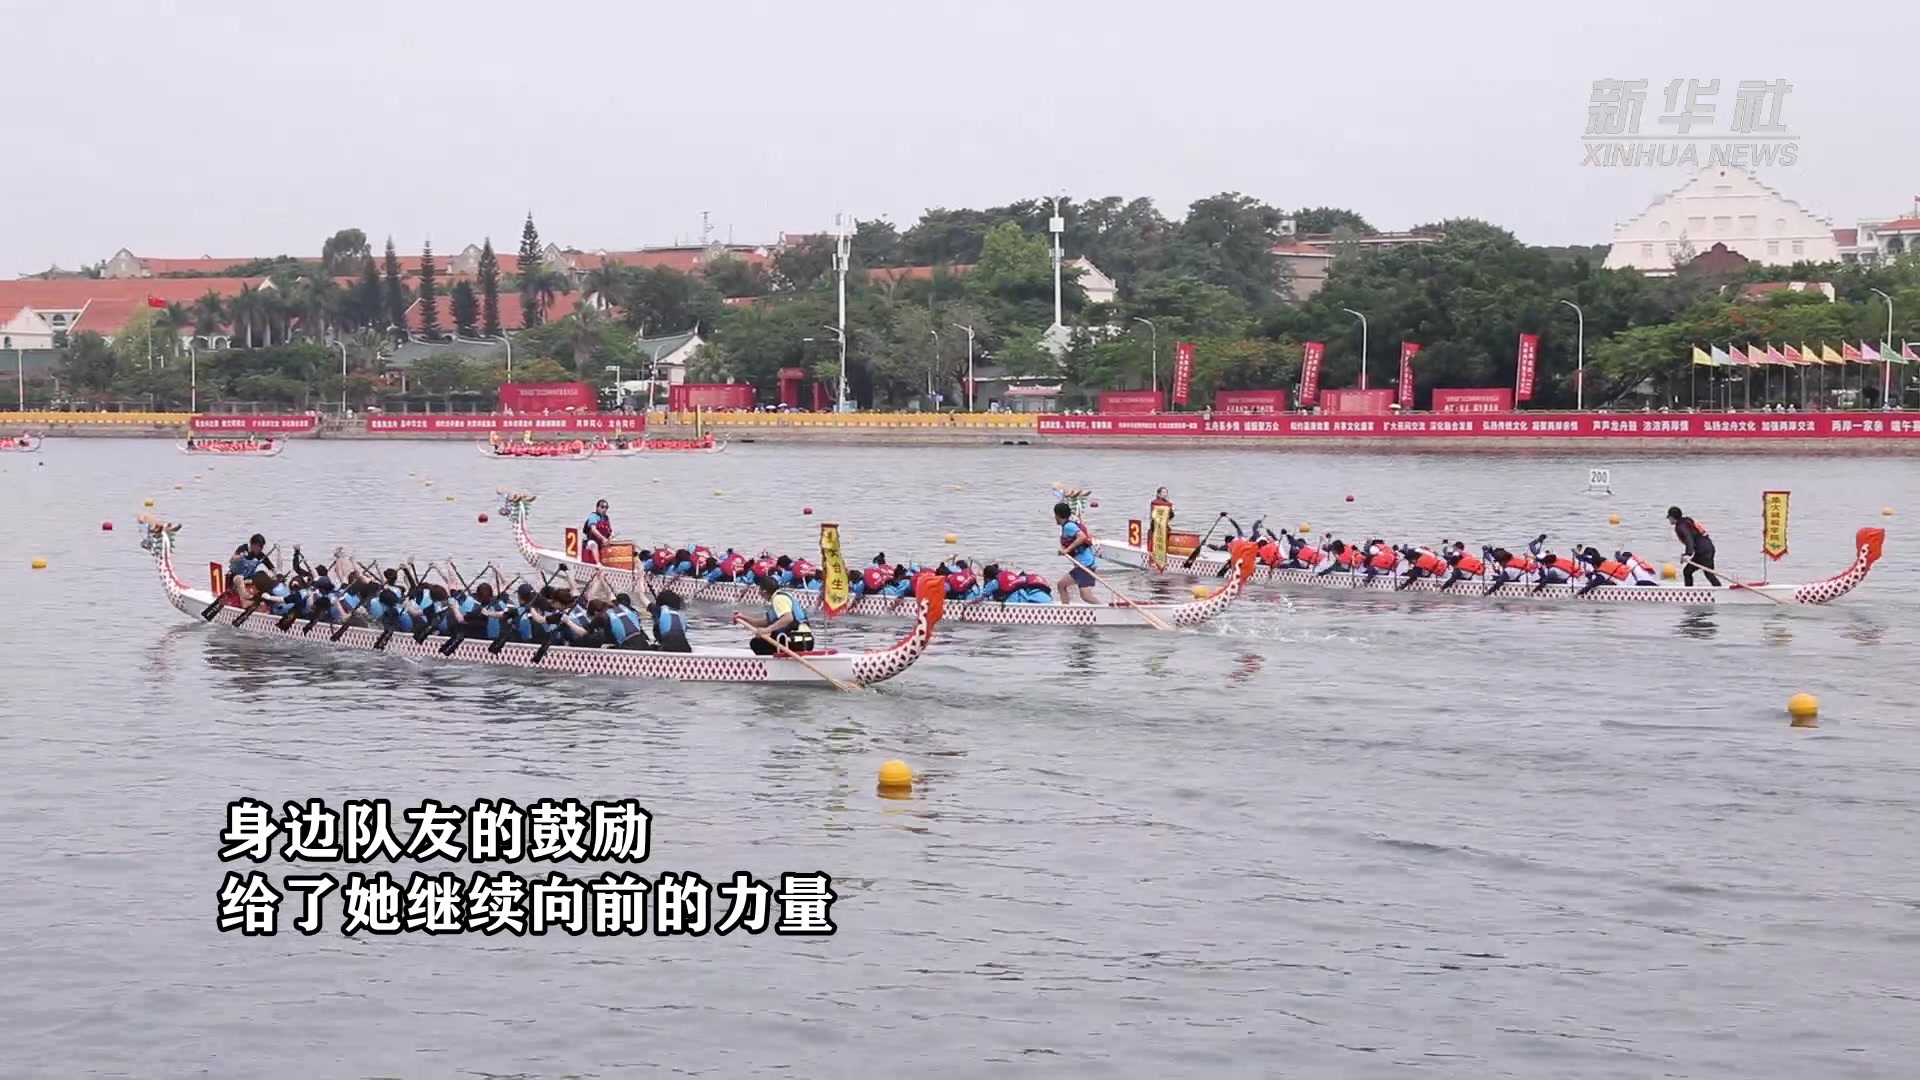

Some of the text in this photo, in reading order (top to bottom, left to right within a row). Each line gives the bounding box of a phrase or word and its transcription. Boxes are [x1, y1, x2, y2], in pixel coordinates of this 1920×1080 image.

[1383, 421, 1473, 431] 扩大民间交流 深化融合发展
[1482, 421, 1527, 431] 弘扬传统文化
[1592, 420, 1689, 431] 声声龙舟鼓 浓浓两岸情
[1704, 421, 1815, 431] 弘扬龙舟文化 加强两岸交流
[1831, 420, 1883, 432] 两岸一家亲
[1591, 471, 1607, 483] 200
[1130, 523, 1140, 545] 3
[566, 532, 577, 555] 2
[213, 568, 221, 596] 1
